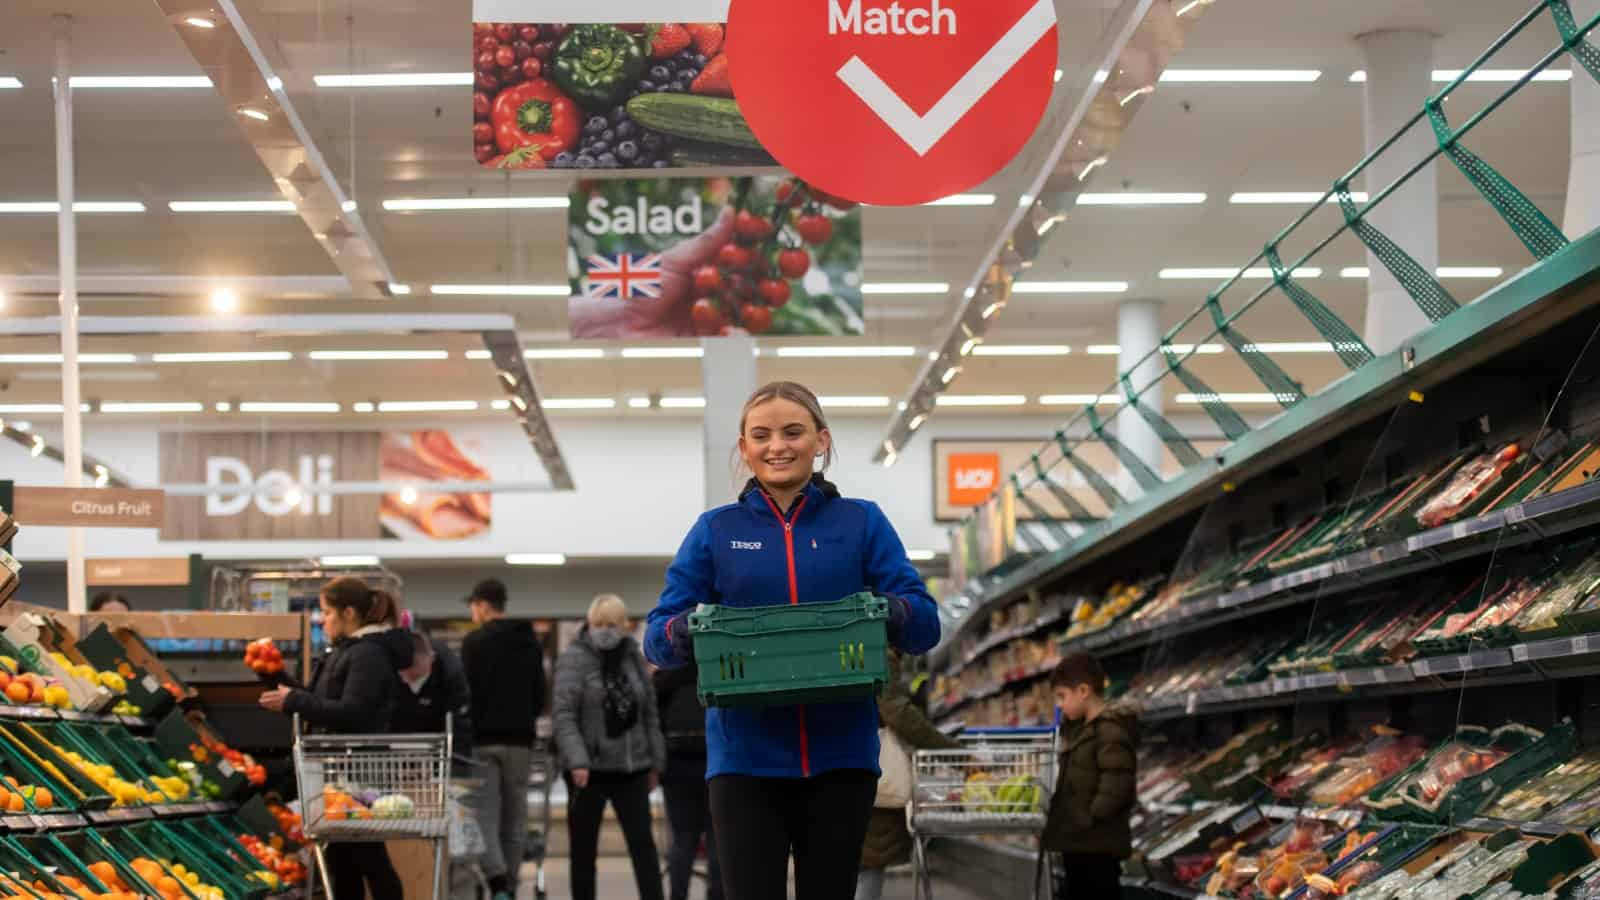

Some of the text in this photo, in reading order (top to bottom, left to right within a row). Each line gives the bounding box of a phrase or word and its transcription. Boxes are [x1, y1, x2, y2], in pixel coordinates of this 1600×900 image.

[828, 0, 957, 35] Match
[586, 196, 701, 235] Salad
[206, 455, 333, 516] Deli
[71, 501, 152, 515] Citrus Fruit
